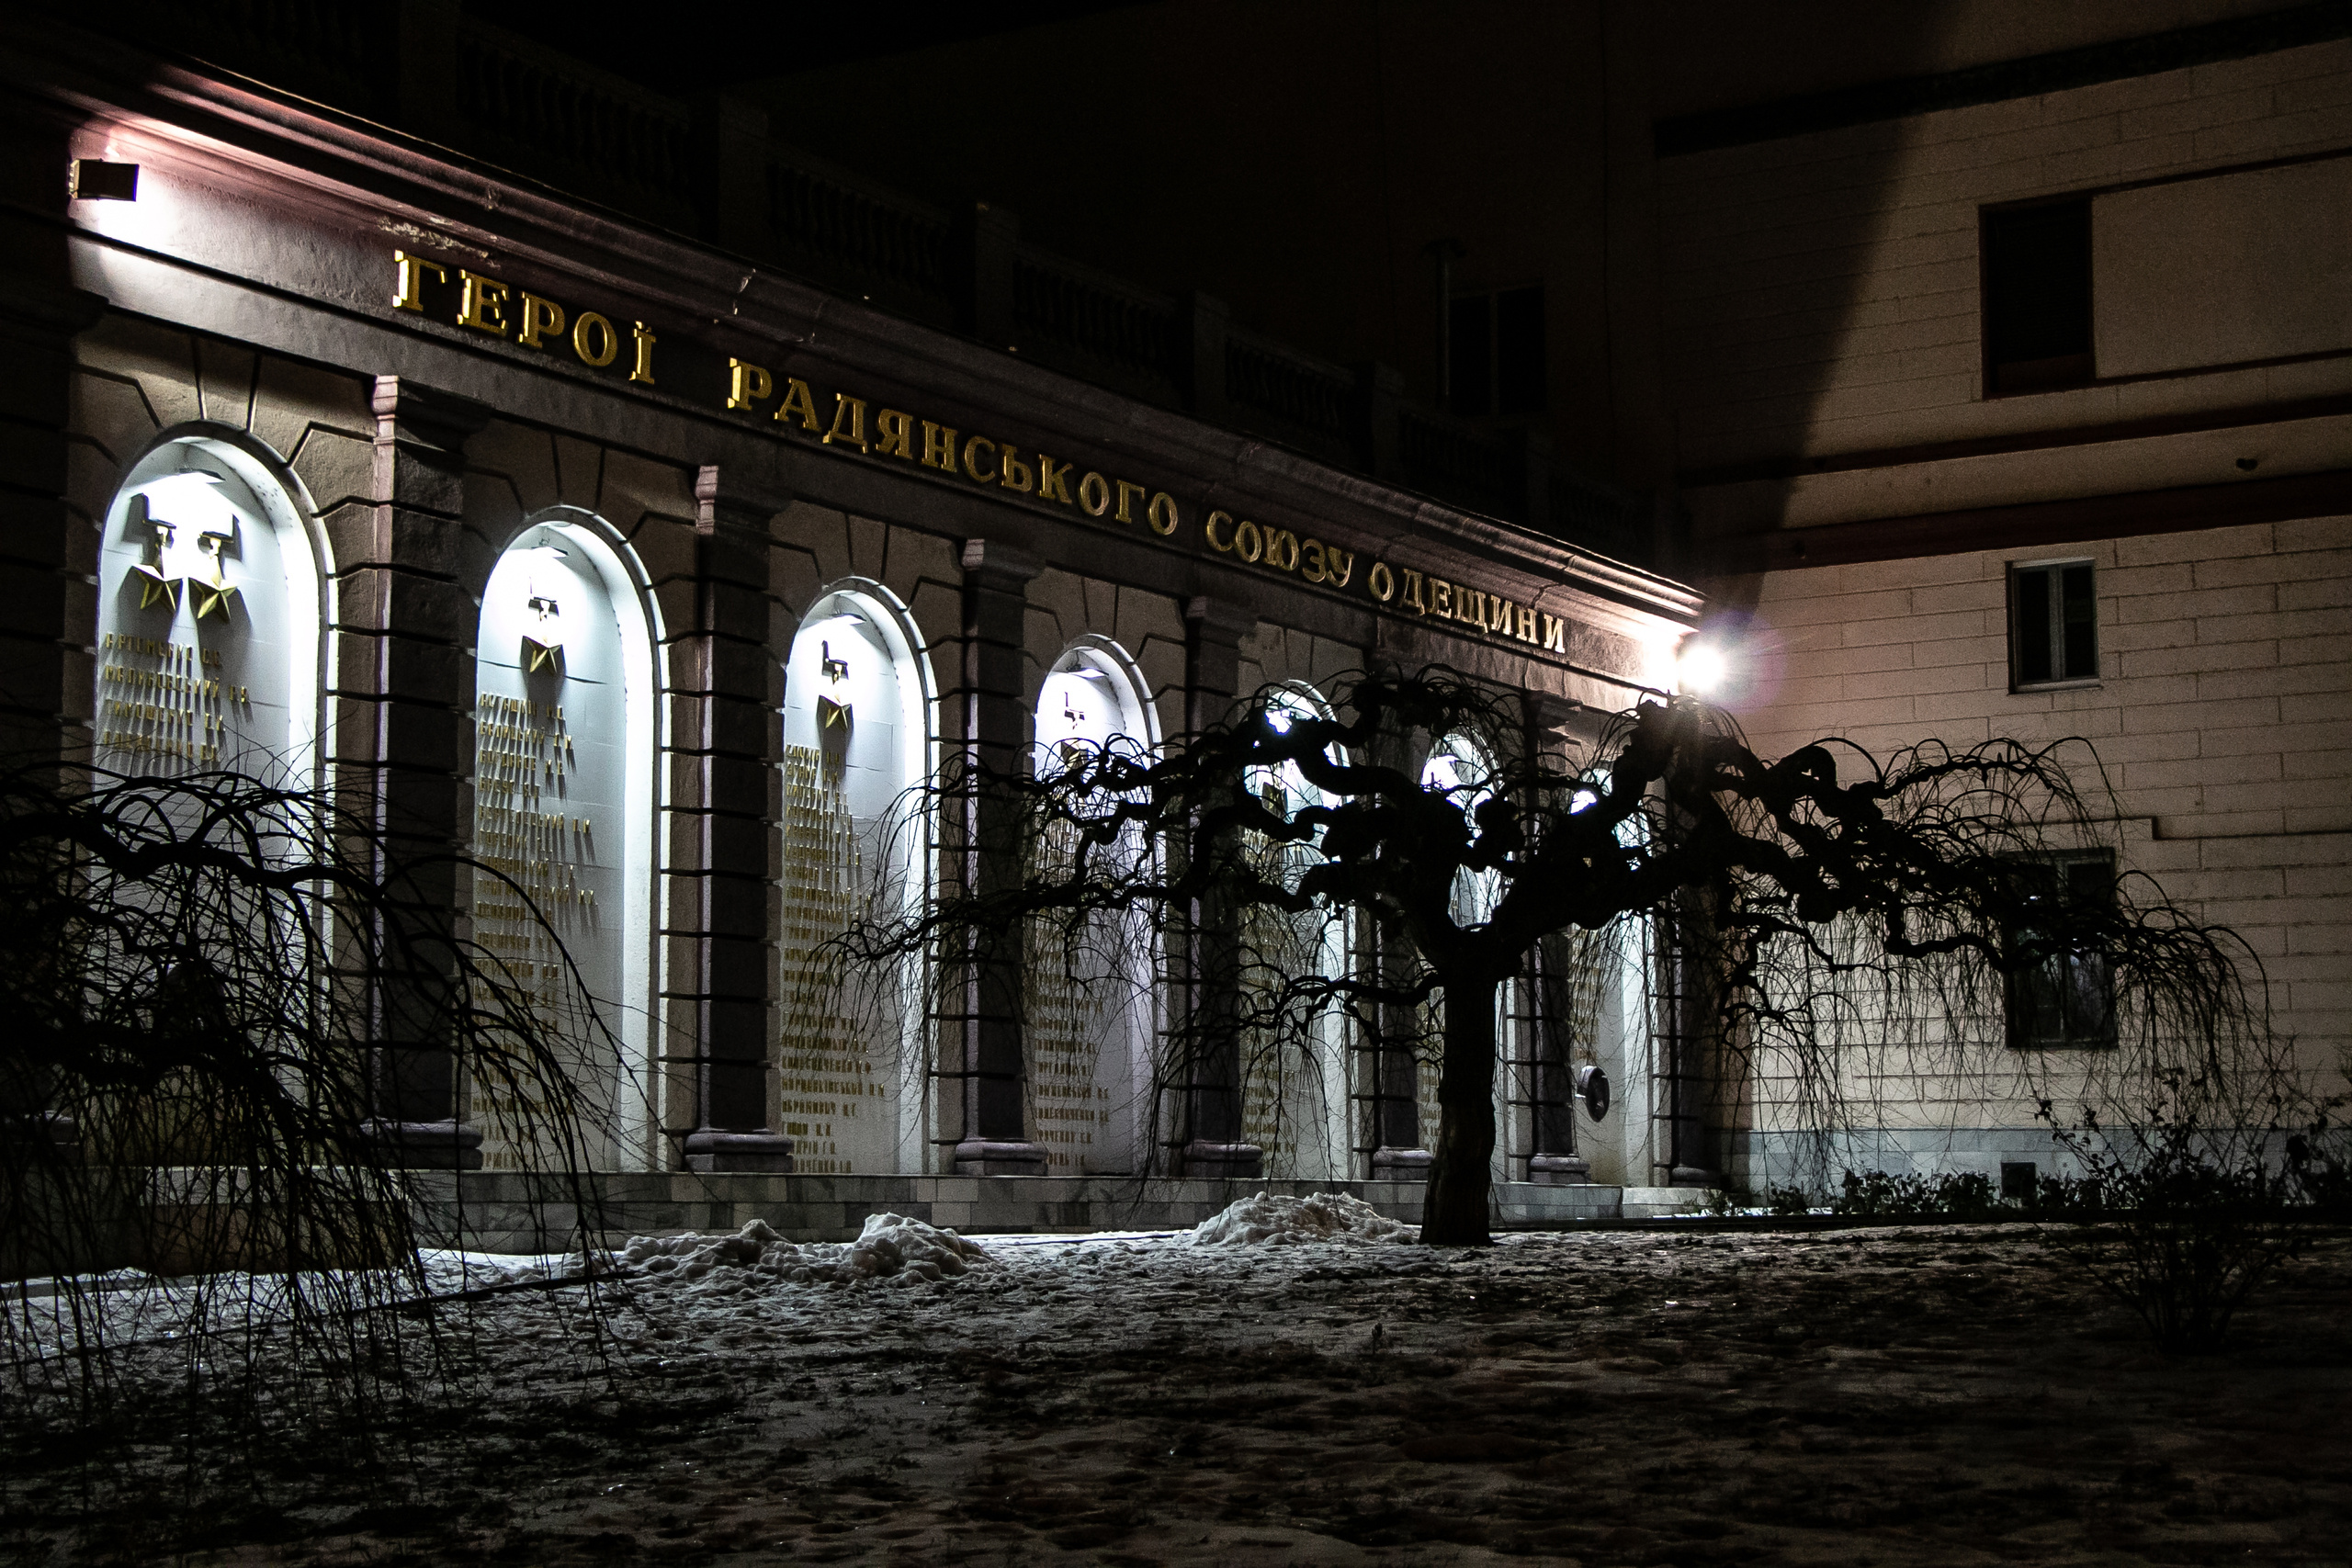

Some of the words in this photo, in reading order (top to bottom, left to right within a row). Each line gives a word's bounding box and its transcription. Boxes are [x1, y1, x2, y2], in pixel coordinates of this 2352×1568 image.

[391, 249, 656, 385] ГЕРОЇ
[727, 357, 1179, 536] РАДЯНСЬКОГО
[1205, 510, 1355, 588] СОЮЗУ
[1367, 561, 1566, 655] ОДЕЩИНИ
